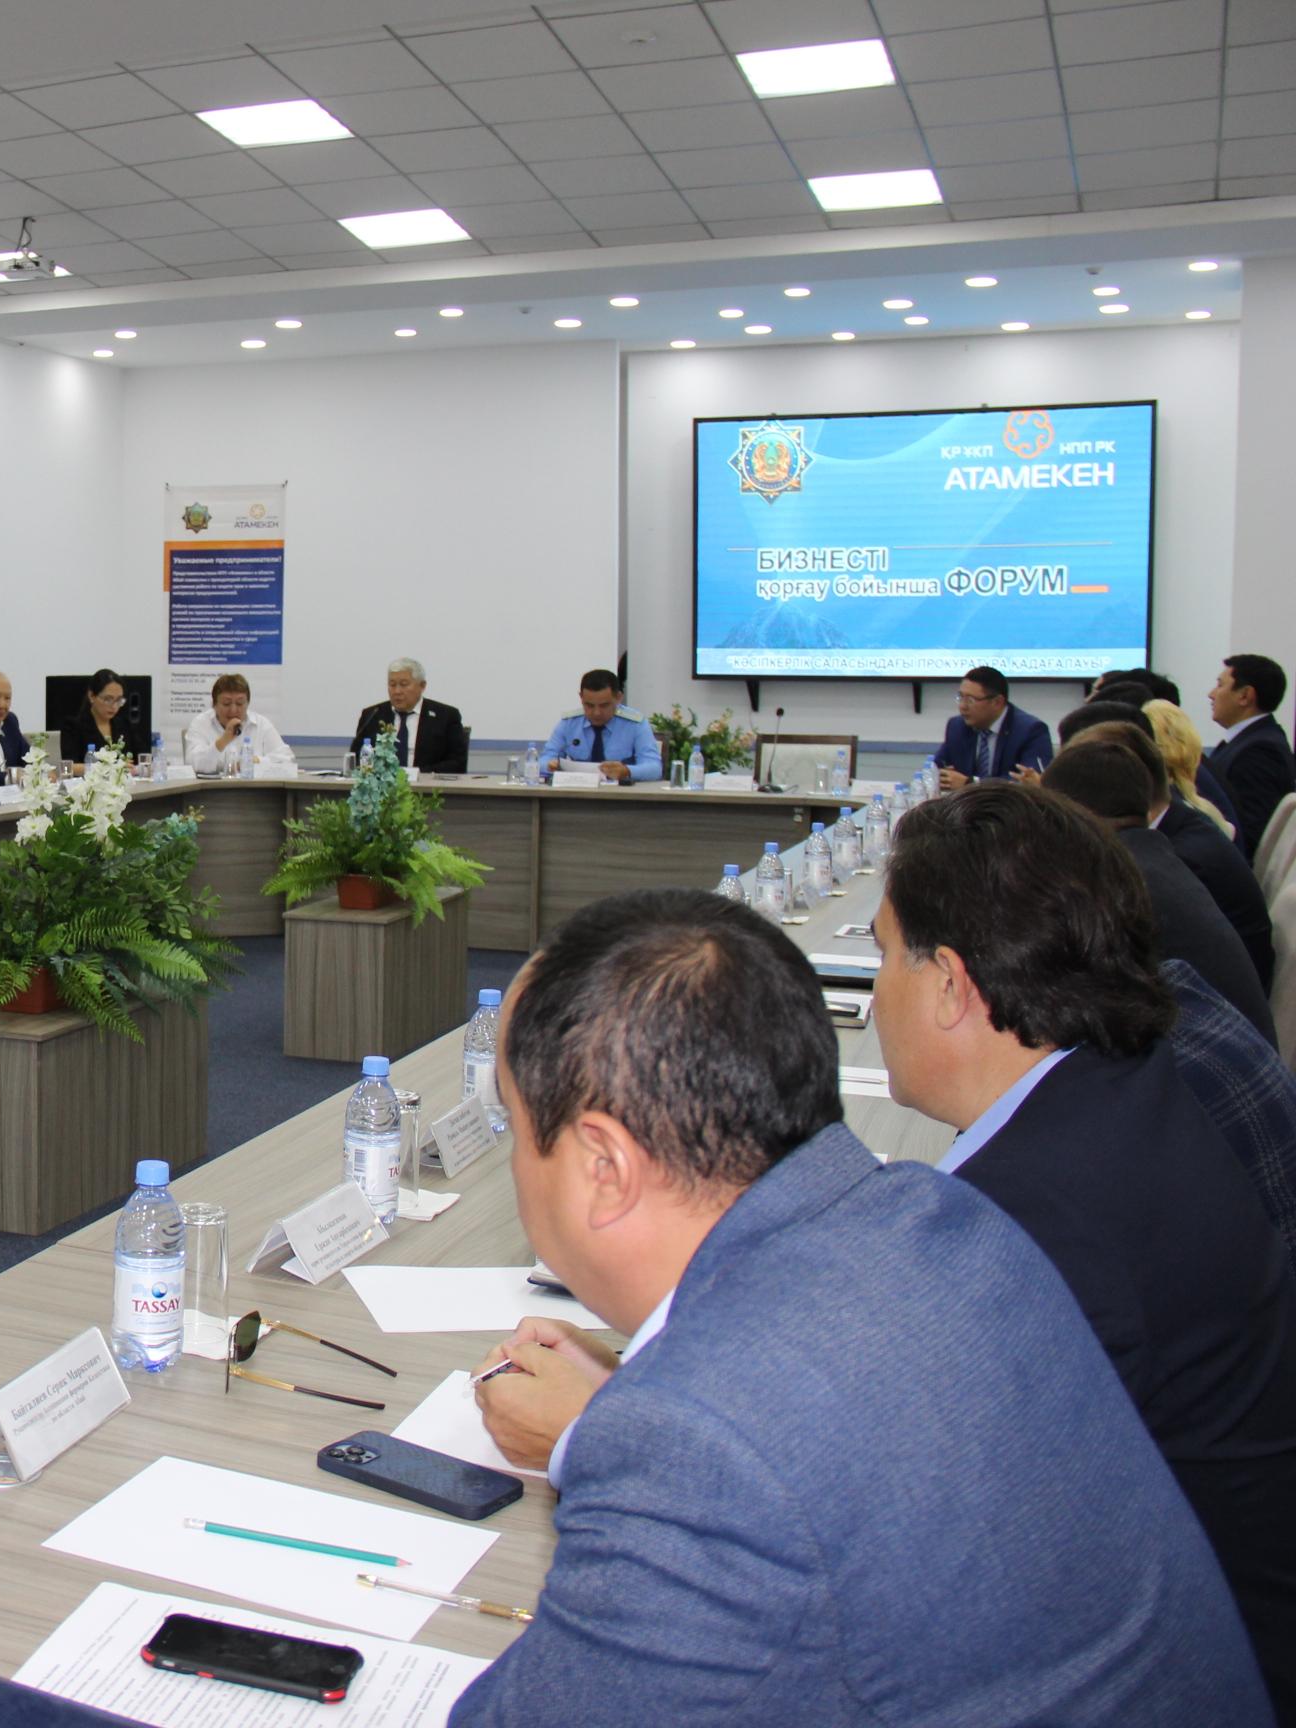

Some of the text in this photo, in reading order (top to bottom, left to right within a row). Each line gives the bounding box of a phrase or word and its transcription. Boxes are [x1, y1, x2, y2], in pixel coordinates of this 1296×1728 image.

[1095, 440, 1116, 453] РК
[944, 462, 1115, 491] АТАМЕКЕН
[757, 548, 888, 572] БИЗНЕСТІ
[757, 567, 1066, 599] қорғау бойынша ФОРУМ
[132, 1297, 181, 1313] TASSAY
